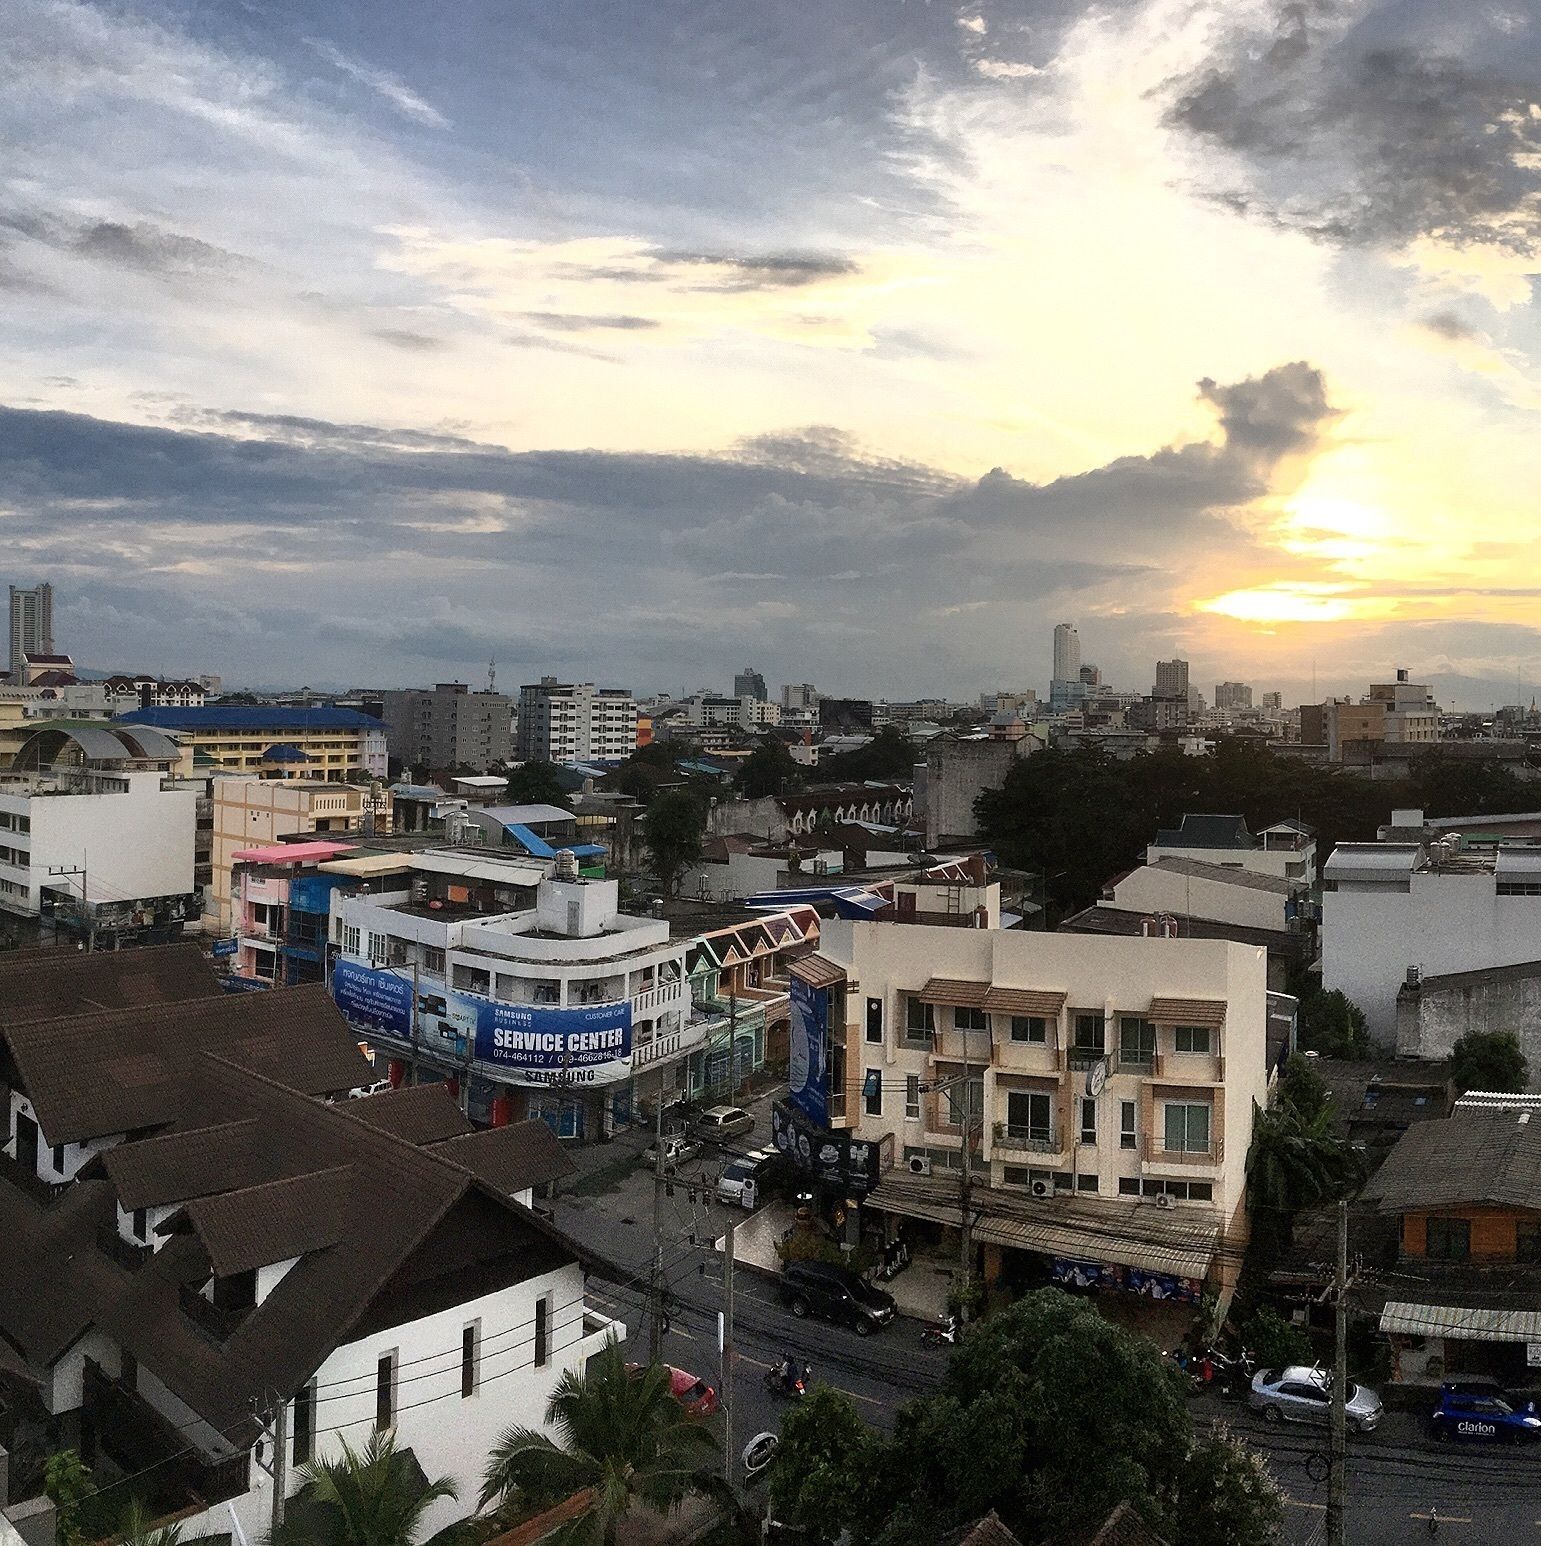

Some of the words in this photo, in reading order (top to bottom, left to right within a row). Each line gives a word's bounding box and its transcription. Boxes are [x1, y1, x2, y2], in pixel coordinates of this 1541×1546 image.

[495, 1009, 532, 1021] SAMSUNG
[494, 1028, 564, 1051] SERVICE
[567, 1028, 623, 1051] CENTER
[493, 1049, 544, 1064] 074-464112
[525, 1070, 595, 1084] SAMSUNG
[1458, 1421, 1495, 1433] Clarion
